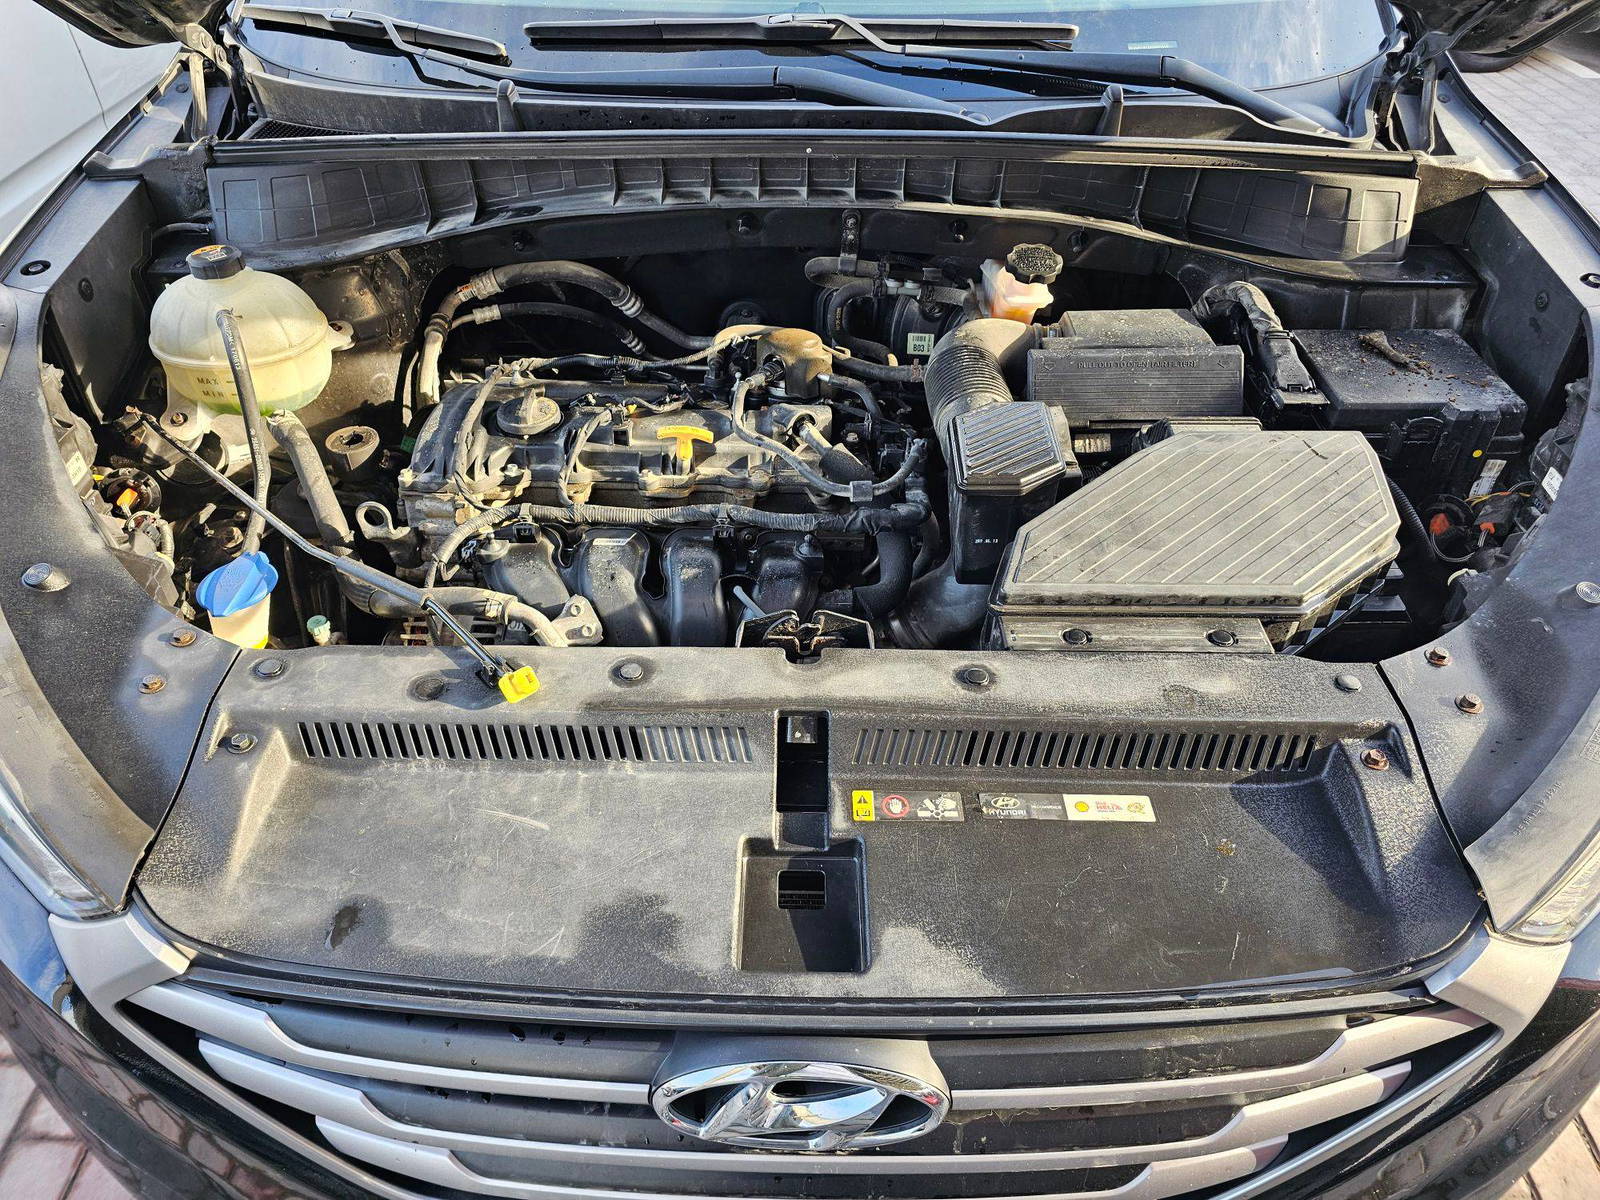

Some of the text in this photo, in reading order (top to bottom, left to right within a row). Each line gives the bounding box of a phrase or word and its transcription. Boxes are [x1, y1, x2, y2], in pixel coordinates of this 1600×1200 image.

[196, 377, 219, 385] MAX
[202, 390, 225, 398] MIN
[988, 808, 1027, 818] HYUNDAI
